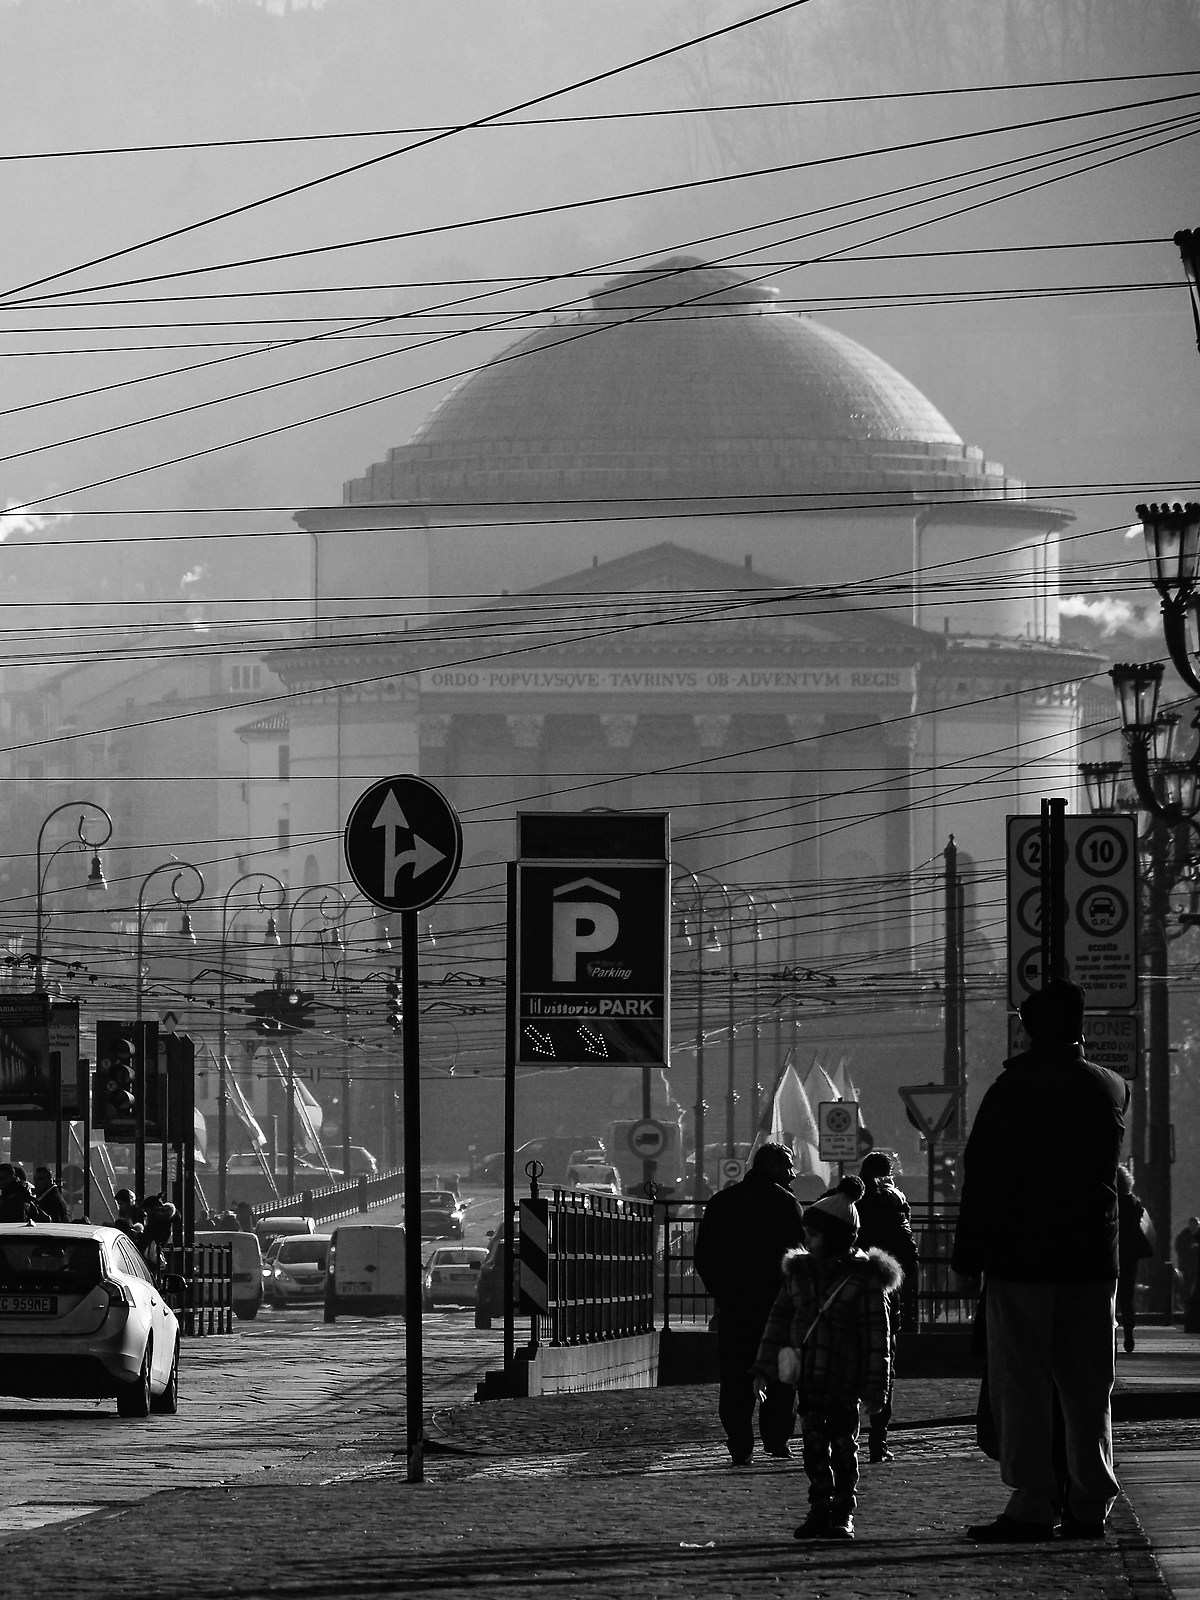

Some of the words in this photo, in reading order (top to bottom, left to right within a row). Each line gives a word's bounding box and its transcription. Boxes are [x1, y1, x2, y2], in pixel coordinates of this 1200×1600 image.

[432, 673, 478, 686] ORDO
[611, 673, 697, 686] TAVRINVS
[707, 673, 729, 686] OB
[736, 673, 840, 686] ADVENTVM
[851, 673, 900, 686] REGIS
[1089, 840, 1114, 863] 10
[552, 901, 619, 982] P
[591, 967, 632, 980] Parking
